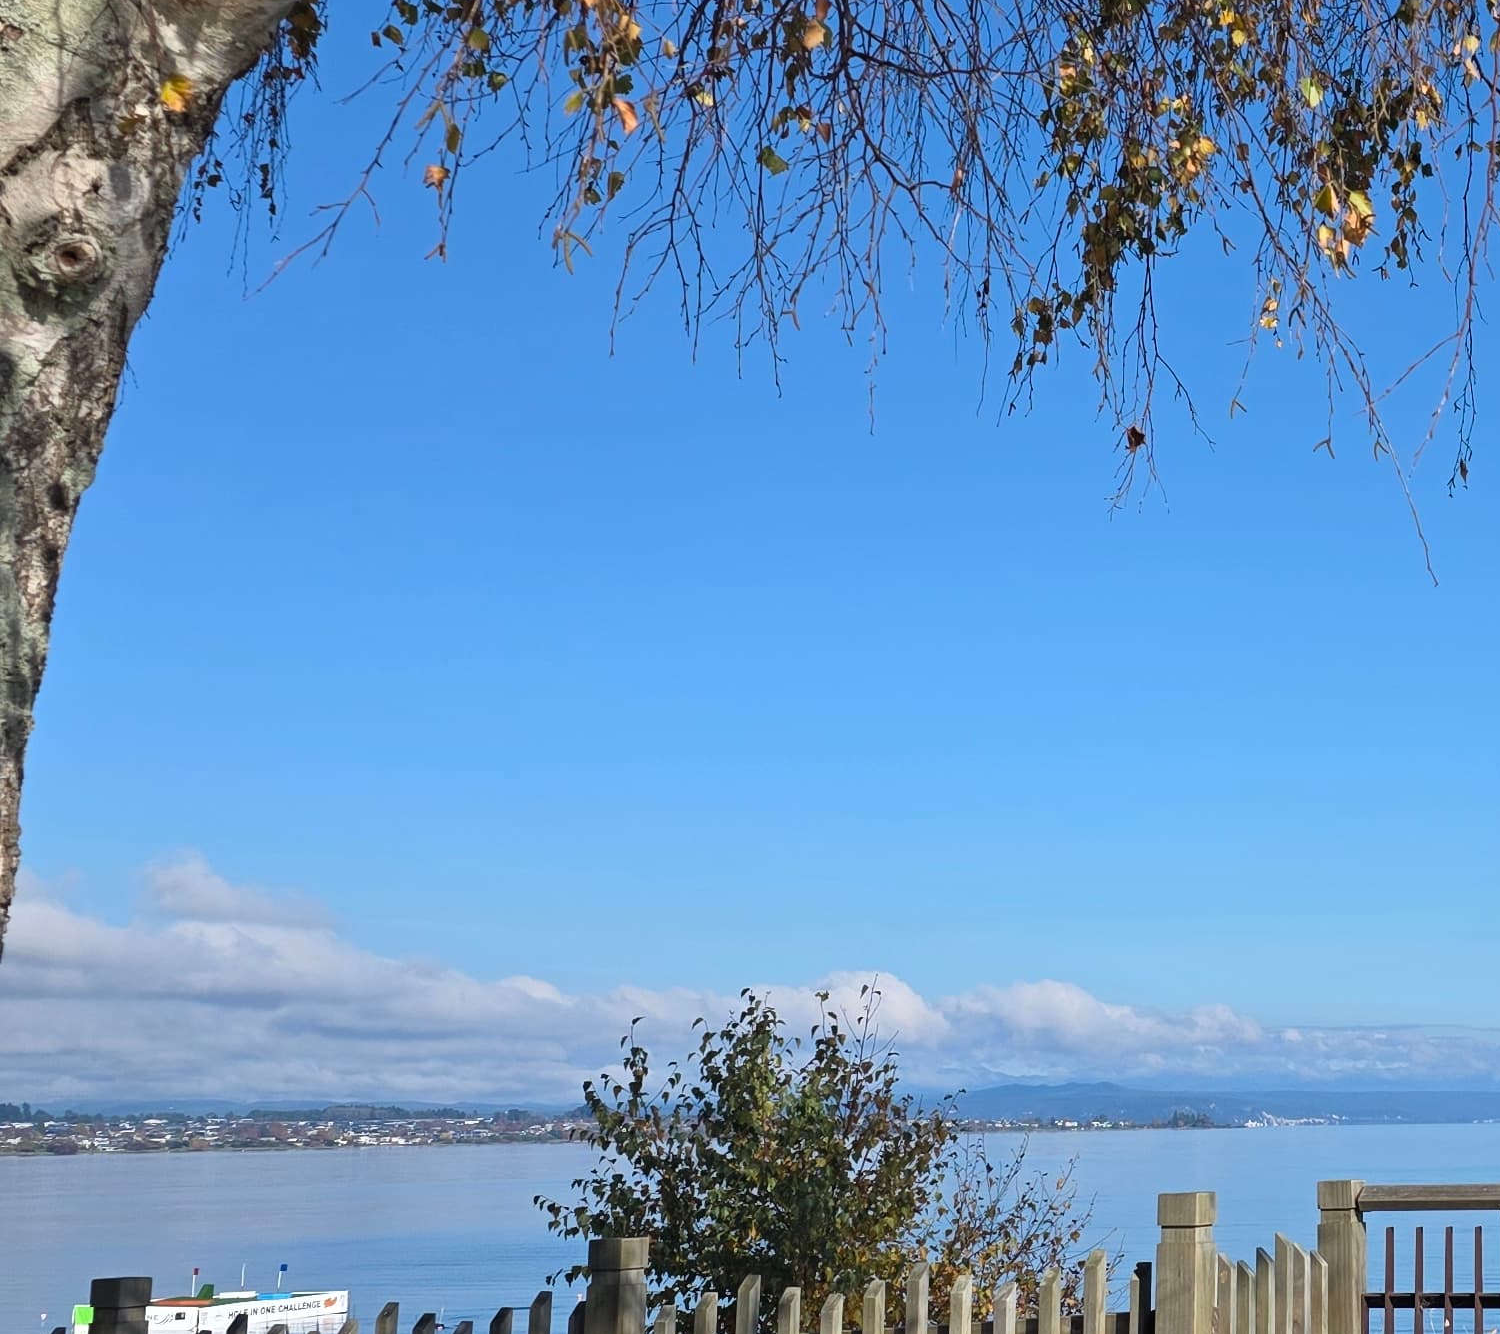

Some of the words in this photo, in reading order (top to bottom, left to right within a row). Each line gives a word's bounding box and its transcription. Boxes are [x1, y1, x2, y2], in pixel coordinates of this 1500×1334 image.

[250, 1308, 258, 1316] IN
[261, 1306, 276, 1315] ONE
[278, 1301, 321, 1313] CHALLENGE
